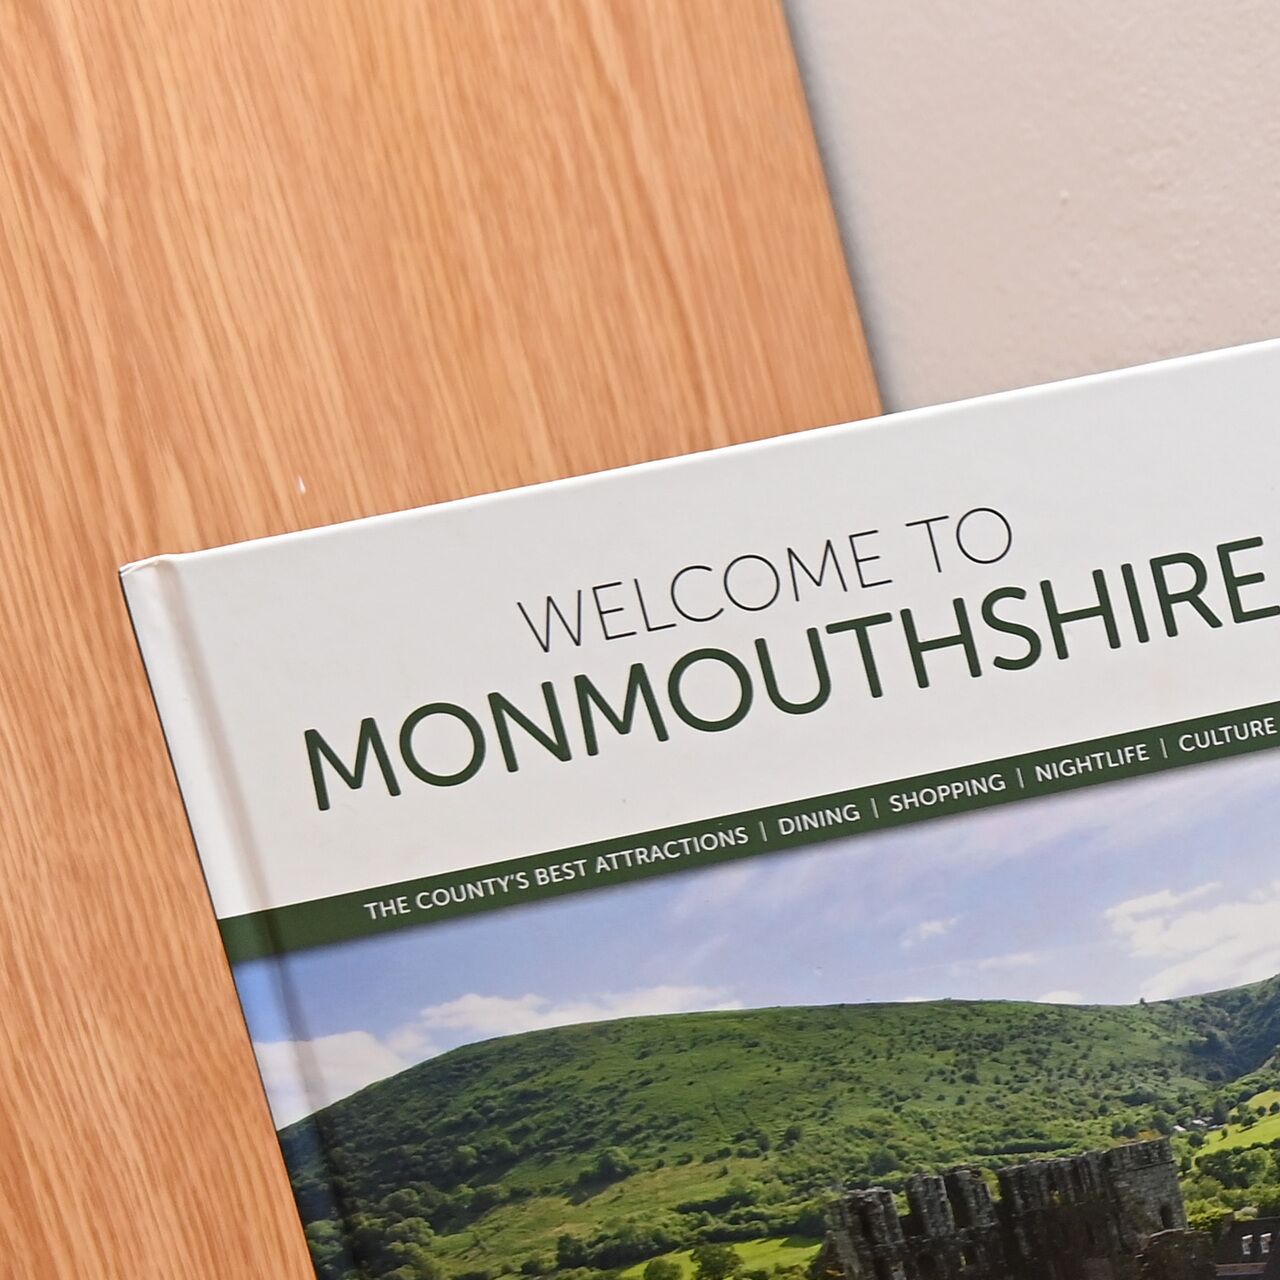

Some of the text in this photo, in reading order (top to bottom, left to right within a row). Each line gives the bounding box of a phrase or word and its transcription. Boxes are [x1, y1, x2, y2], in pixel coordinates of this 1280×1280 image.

[517, 506, 1014, 654] WELCOME TO
[363, 716, 1278, 921] THE COUNTY'S BEST ATTRACTIONS DINING SHOPPING NIGHTLIFE CULTURE
